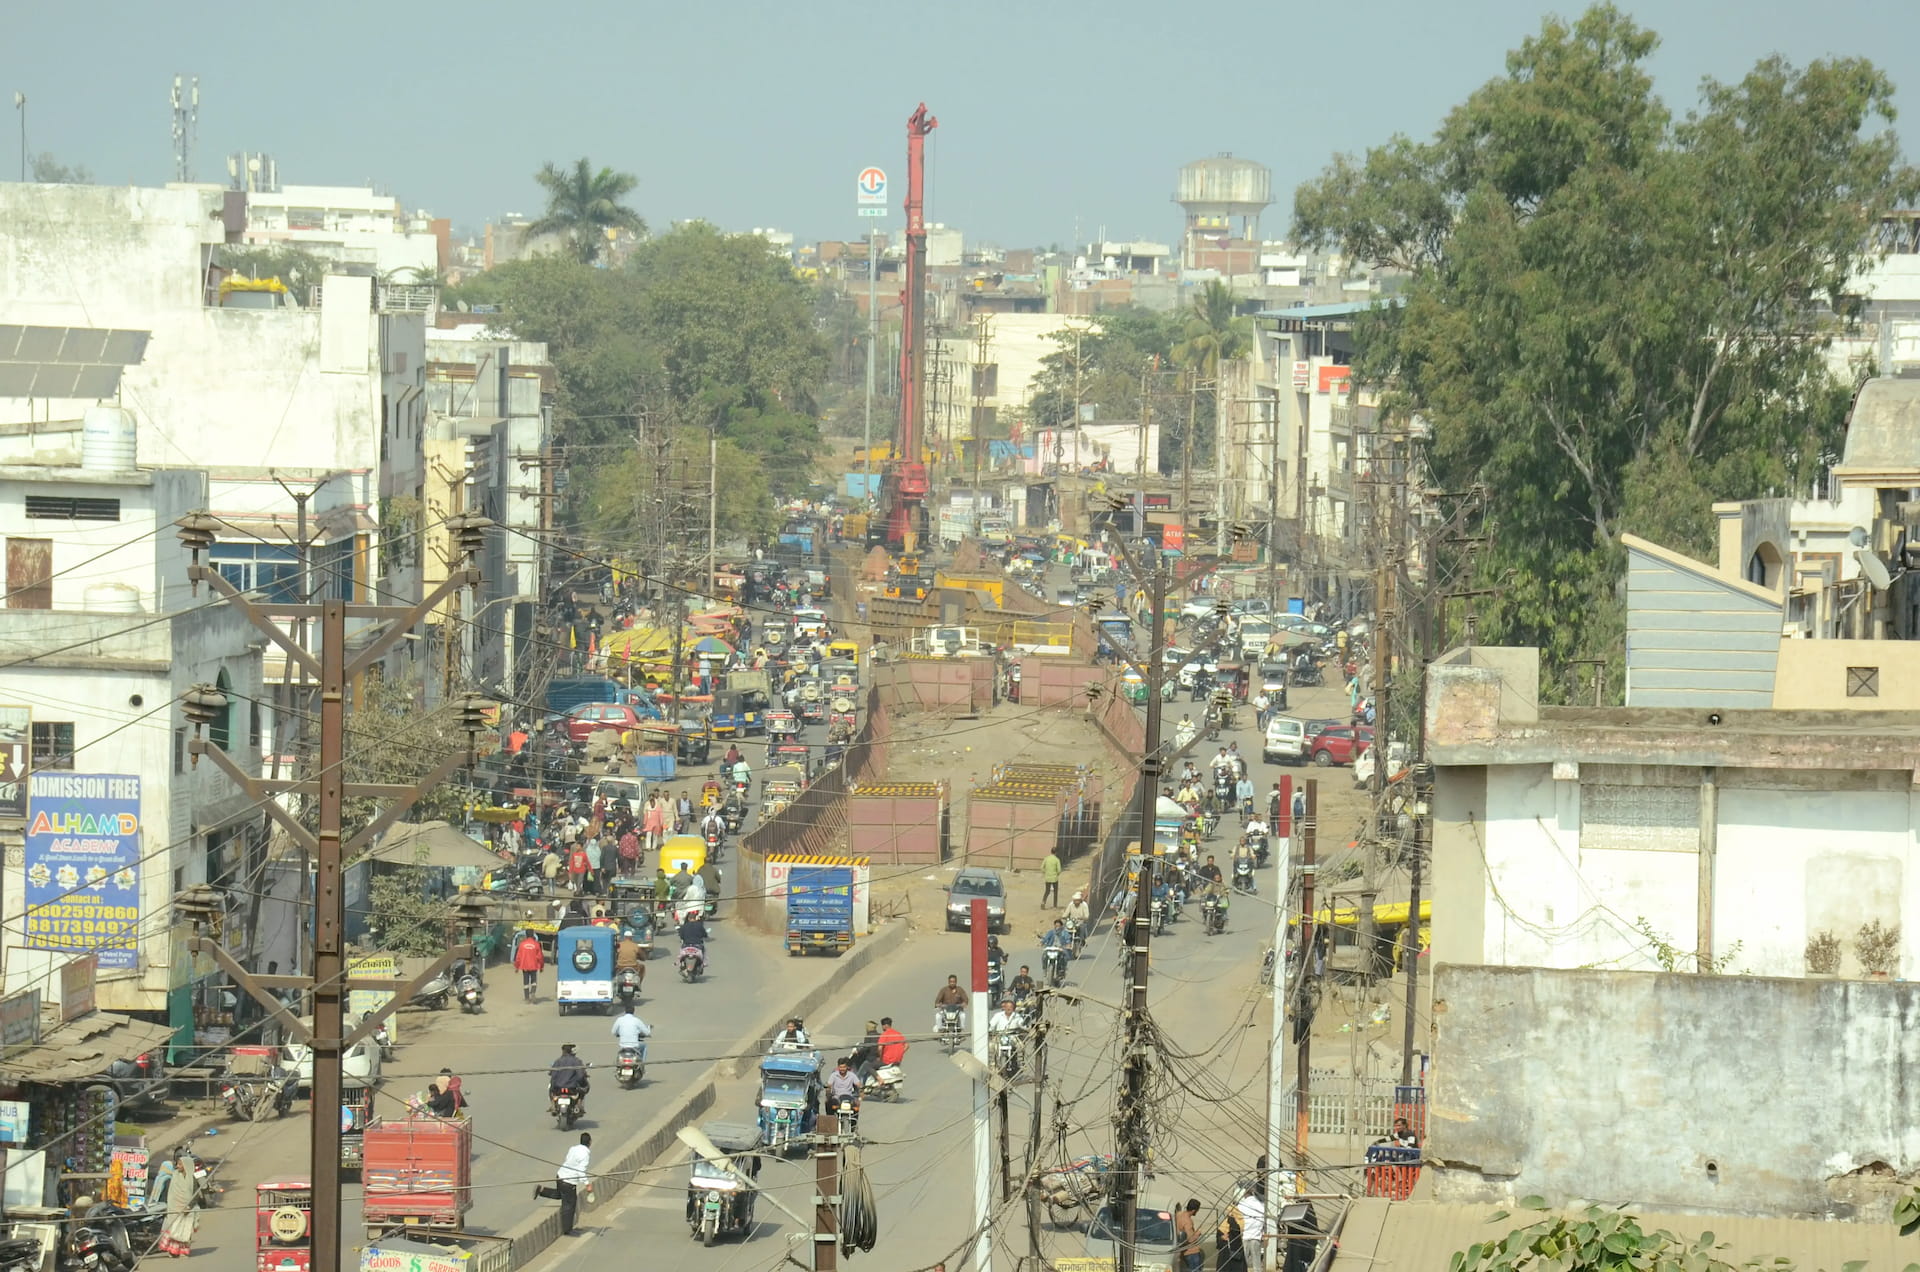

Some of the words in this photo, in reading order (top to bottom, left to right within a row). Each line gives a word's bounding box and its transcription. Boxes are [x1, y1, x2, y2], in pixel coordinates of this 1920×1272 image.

[1165, 530, 1181, 538] ATM
[30, 776, 106, 799] ADMISSION
[108, 779, 139, 799] FREE
[28, 810, 138, 837] ALHAMD
[50, 838, 119, 854] ACADEMY
[0, 1105, 17, 1118] HUB
[369, 1256, 401, 1269] GOODS
